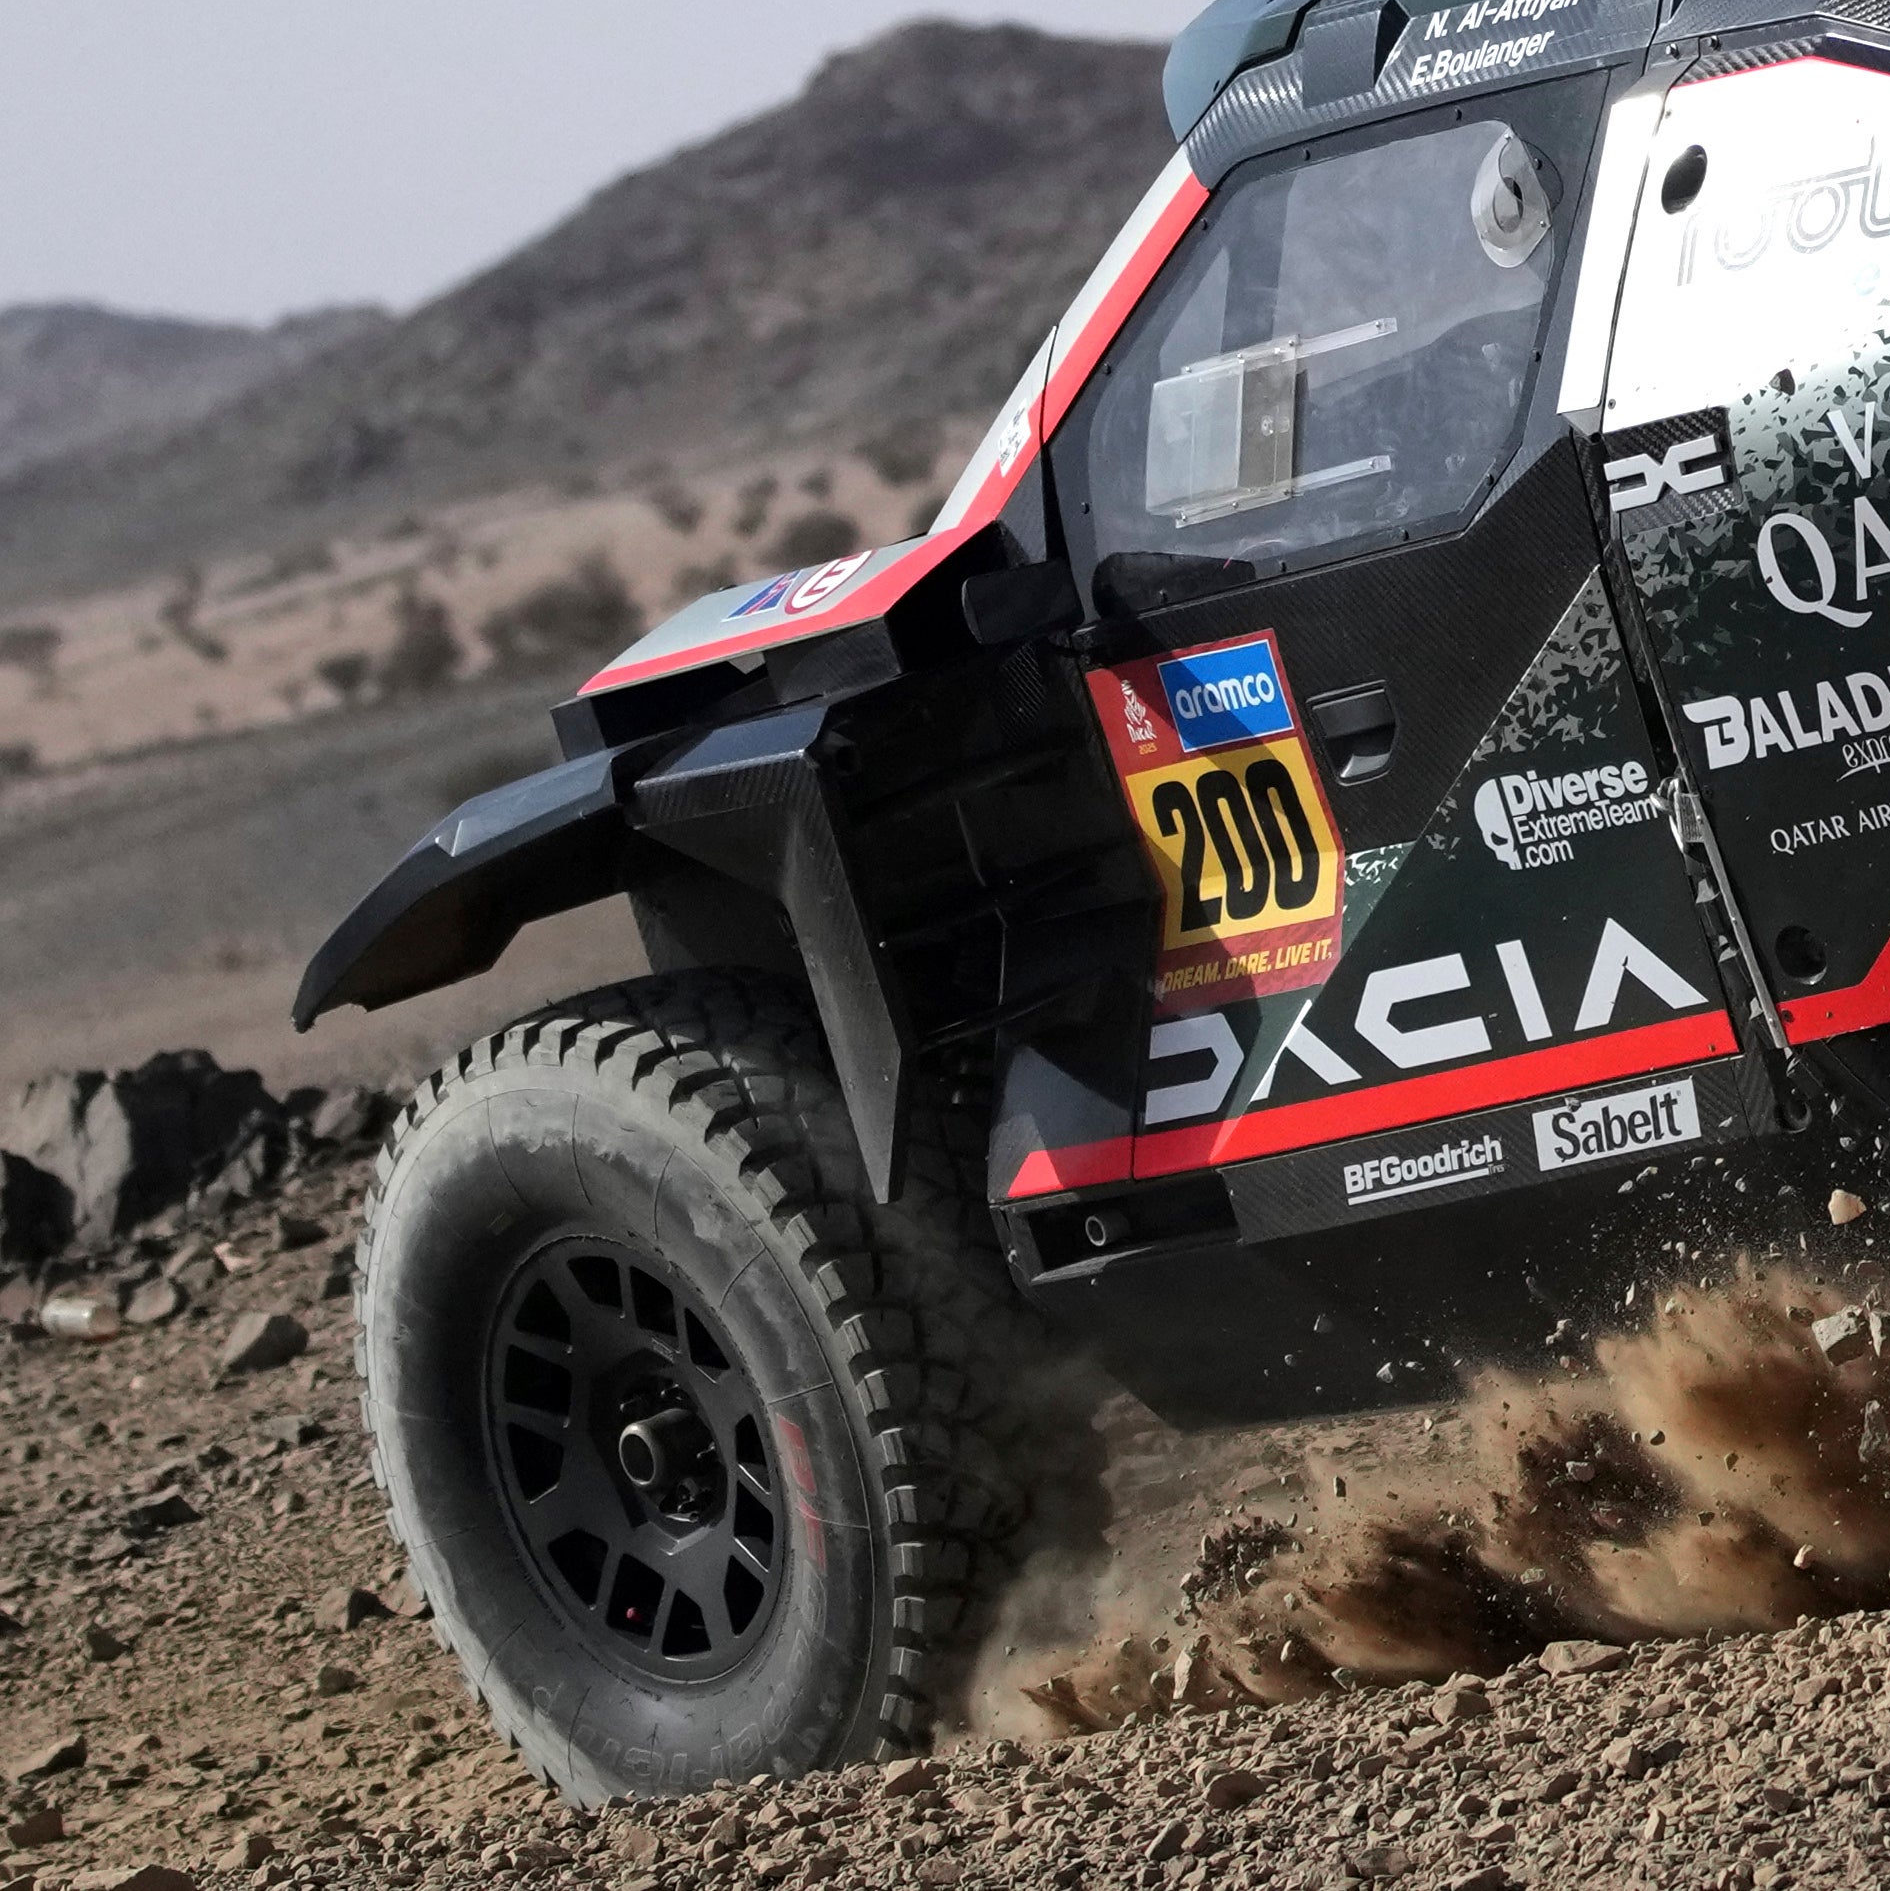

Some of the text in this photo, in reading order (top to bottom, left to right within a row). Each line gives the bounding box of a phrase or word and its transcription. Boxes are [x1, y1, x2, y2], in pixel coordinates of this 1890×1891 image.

[1424, 8, 1451, 41] N.
[1175, 671, 1275, 720] aramco
[1500, 761, 1648, 816] Diverse
[1152, 759, 1319, 932] 200
[1512, 798, 1659, 845] ExtremeTeam
[1770, 814, 1850, 856] QATAR
[1524, 839, 1574, 869] .com
[1162, 961, 1221, 993] DREAM.
[1224, 950, 1272, 981] DARE.
[1275, 941, 1313, 970] LIVE
[1551, 1092, 1683, 1163] Sabelt
[1343, 1134, 1503, 1195] BFGoodrich
